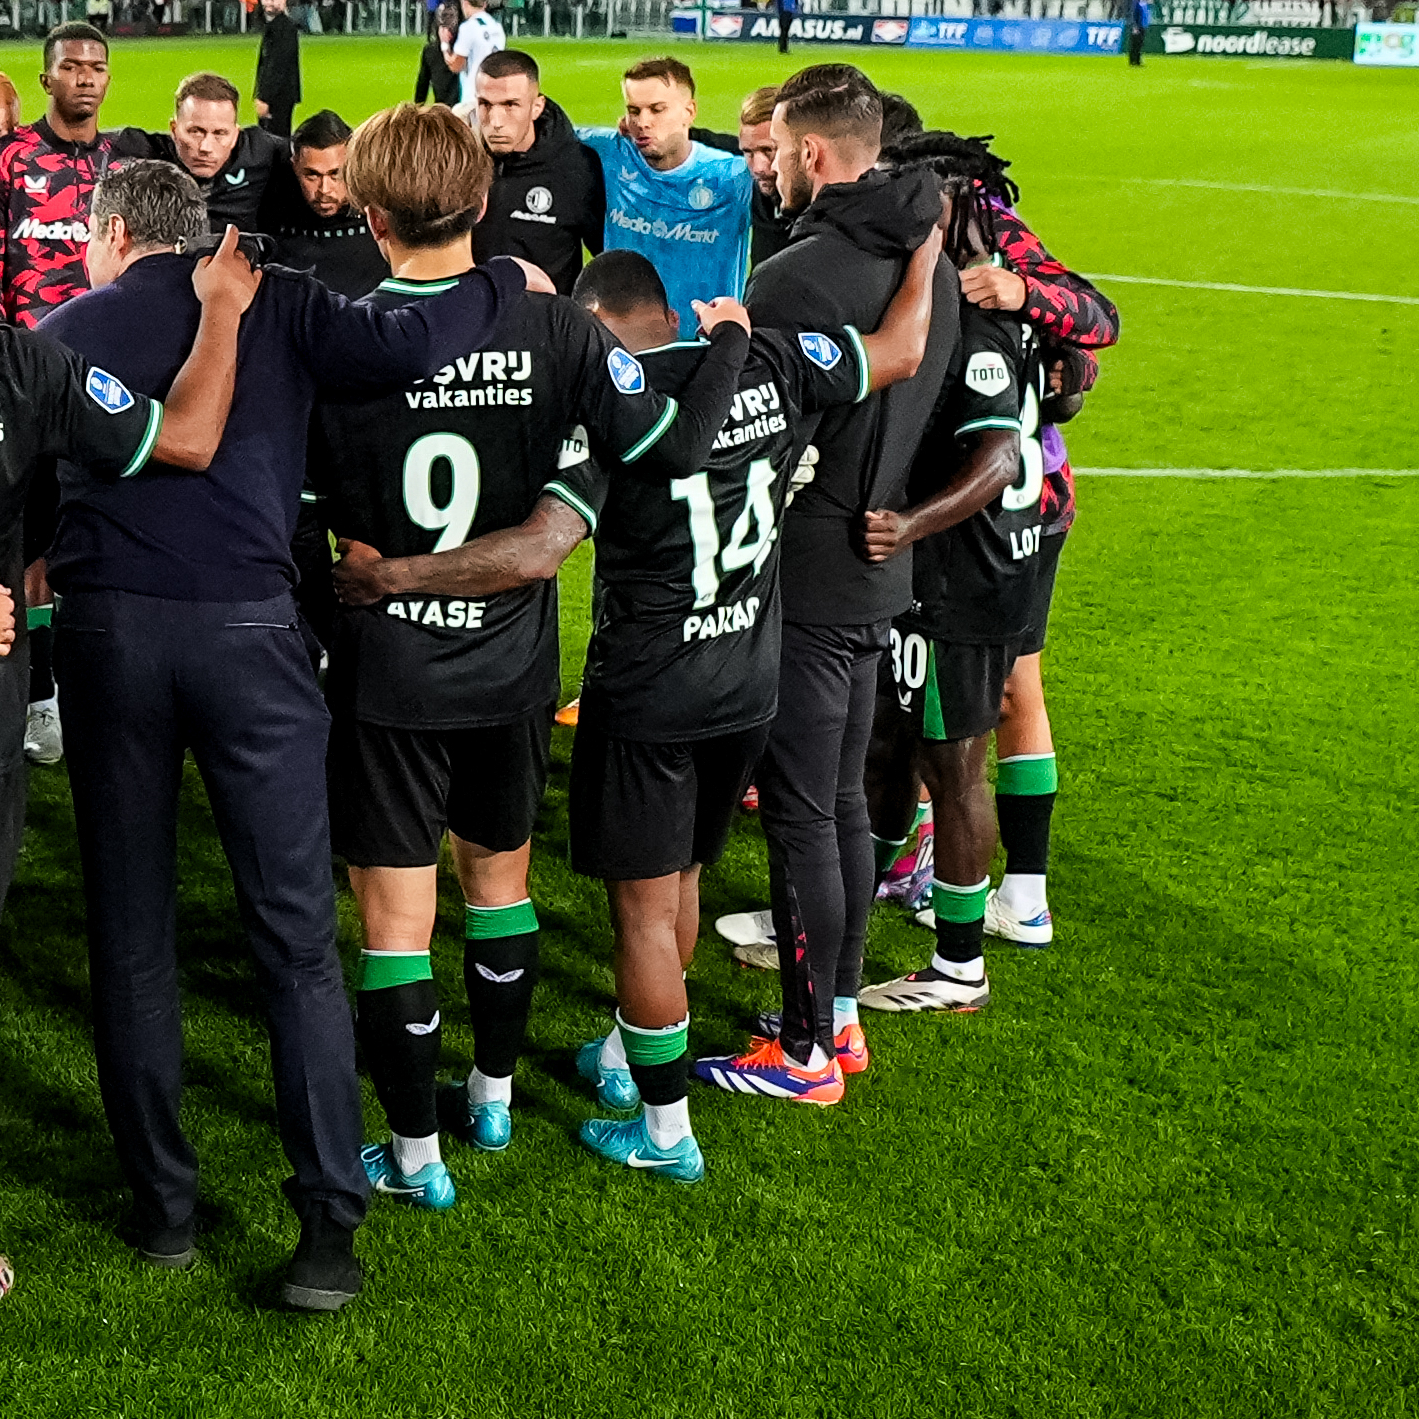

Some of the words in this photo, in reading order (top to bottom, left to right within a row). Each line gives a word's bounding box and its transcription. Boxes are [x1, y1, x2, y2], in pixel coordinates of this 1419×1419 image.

[1196, 31, 1317, 56] noordlease
[405, 383, 533, 409] vakanties
[971, 367, 1005, 382] TOTO
[402, 432, 481, 554] 9
[670, 457, 778, 610] 14
[889, 627, 928, 689] 30
